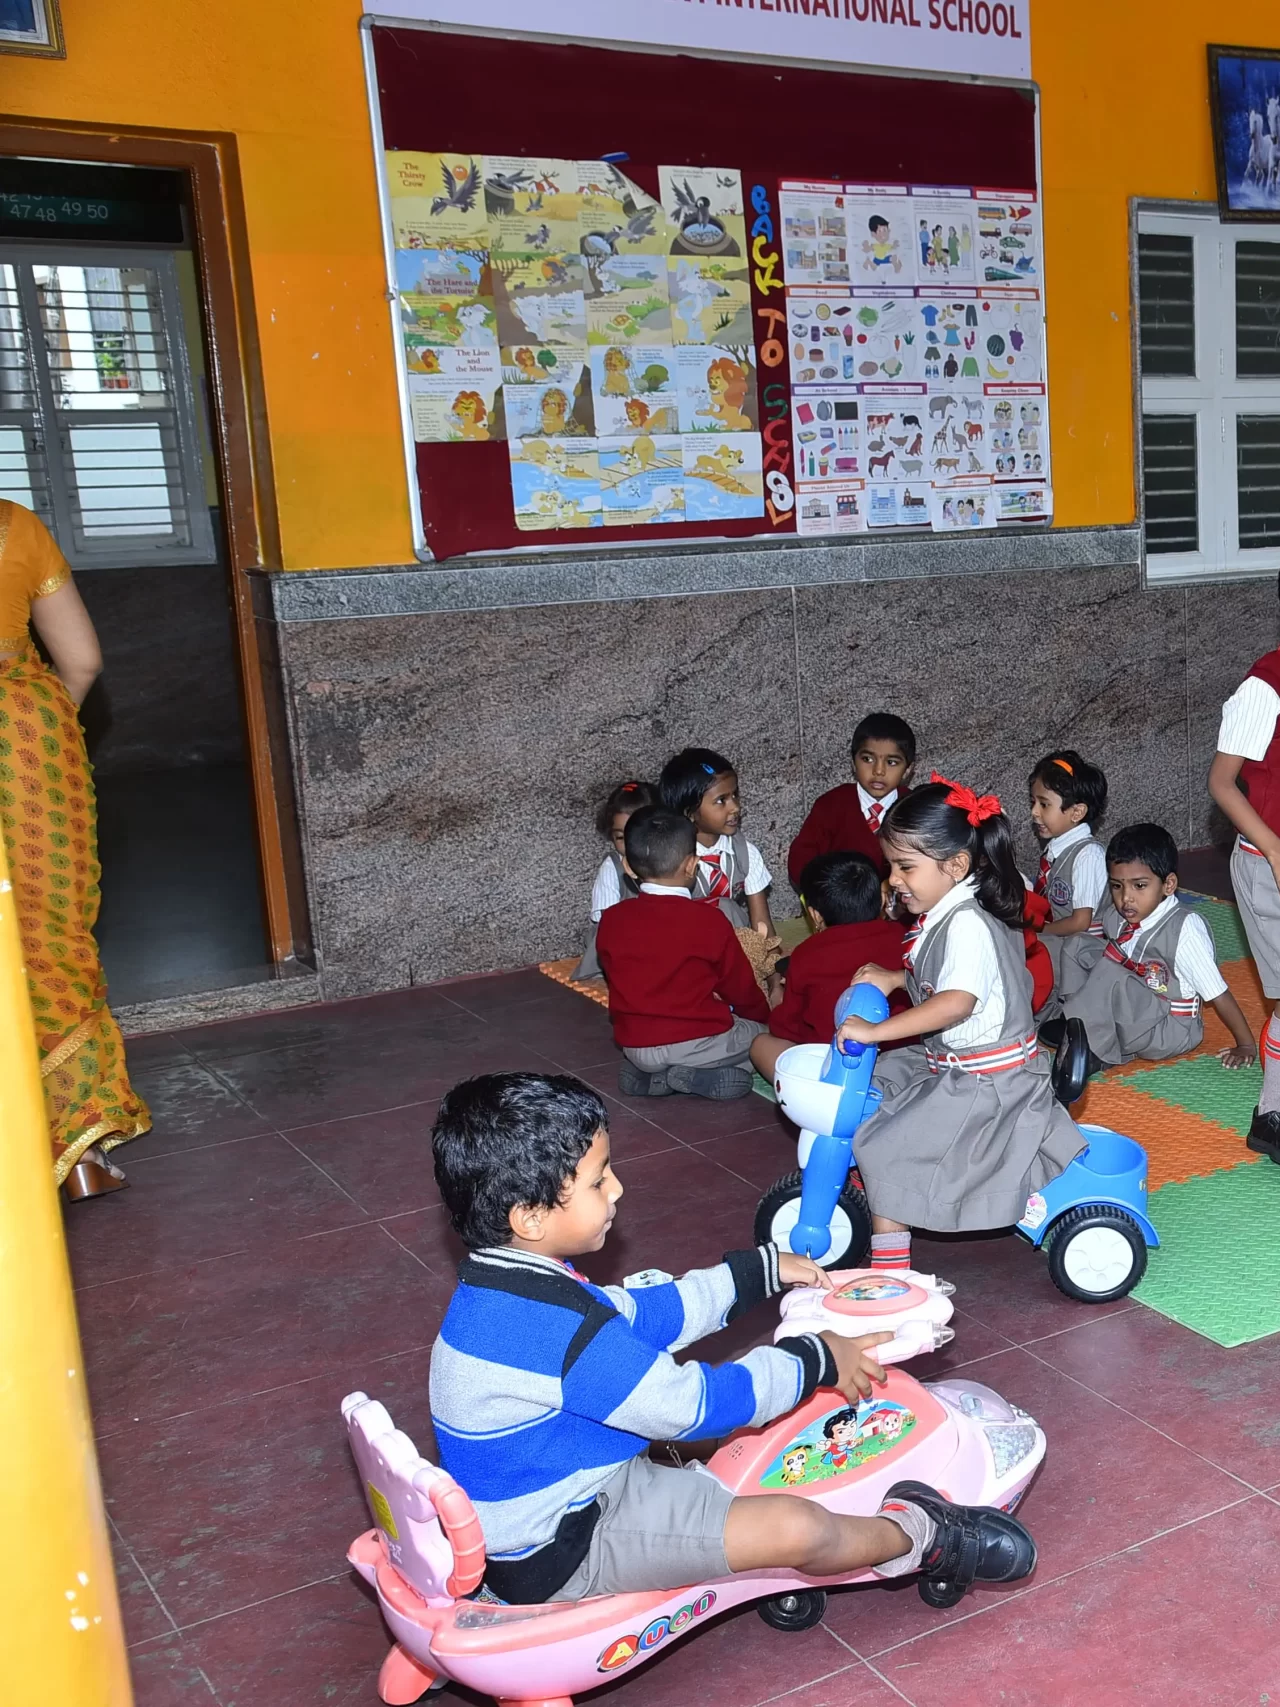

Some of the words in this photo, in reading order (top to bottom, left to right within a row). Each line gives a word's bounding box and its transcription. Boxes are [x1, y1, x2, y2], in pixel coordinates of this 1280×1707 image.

[715, 0, 921, 28] ATIONAL
[928, 0, 1022, 39] SCHOOL
[399, 170, 426, 181] Thirsty
[402, 162, 419, 171] The
[402, 179, 423, 188] Crow
[10, 204, 32, 218] 47
[35, 207, 57, 222] 48
[61, 201, 82, 216] 49
[87, 204, 108, 219] 50
[751, 184, 785, 296] BACK
[757, 308, 786, 367] TO
[763, 384, 795, 527] SCHOOL
